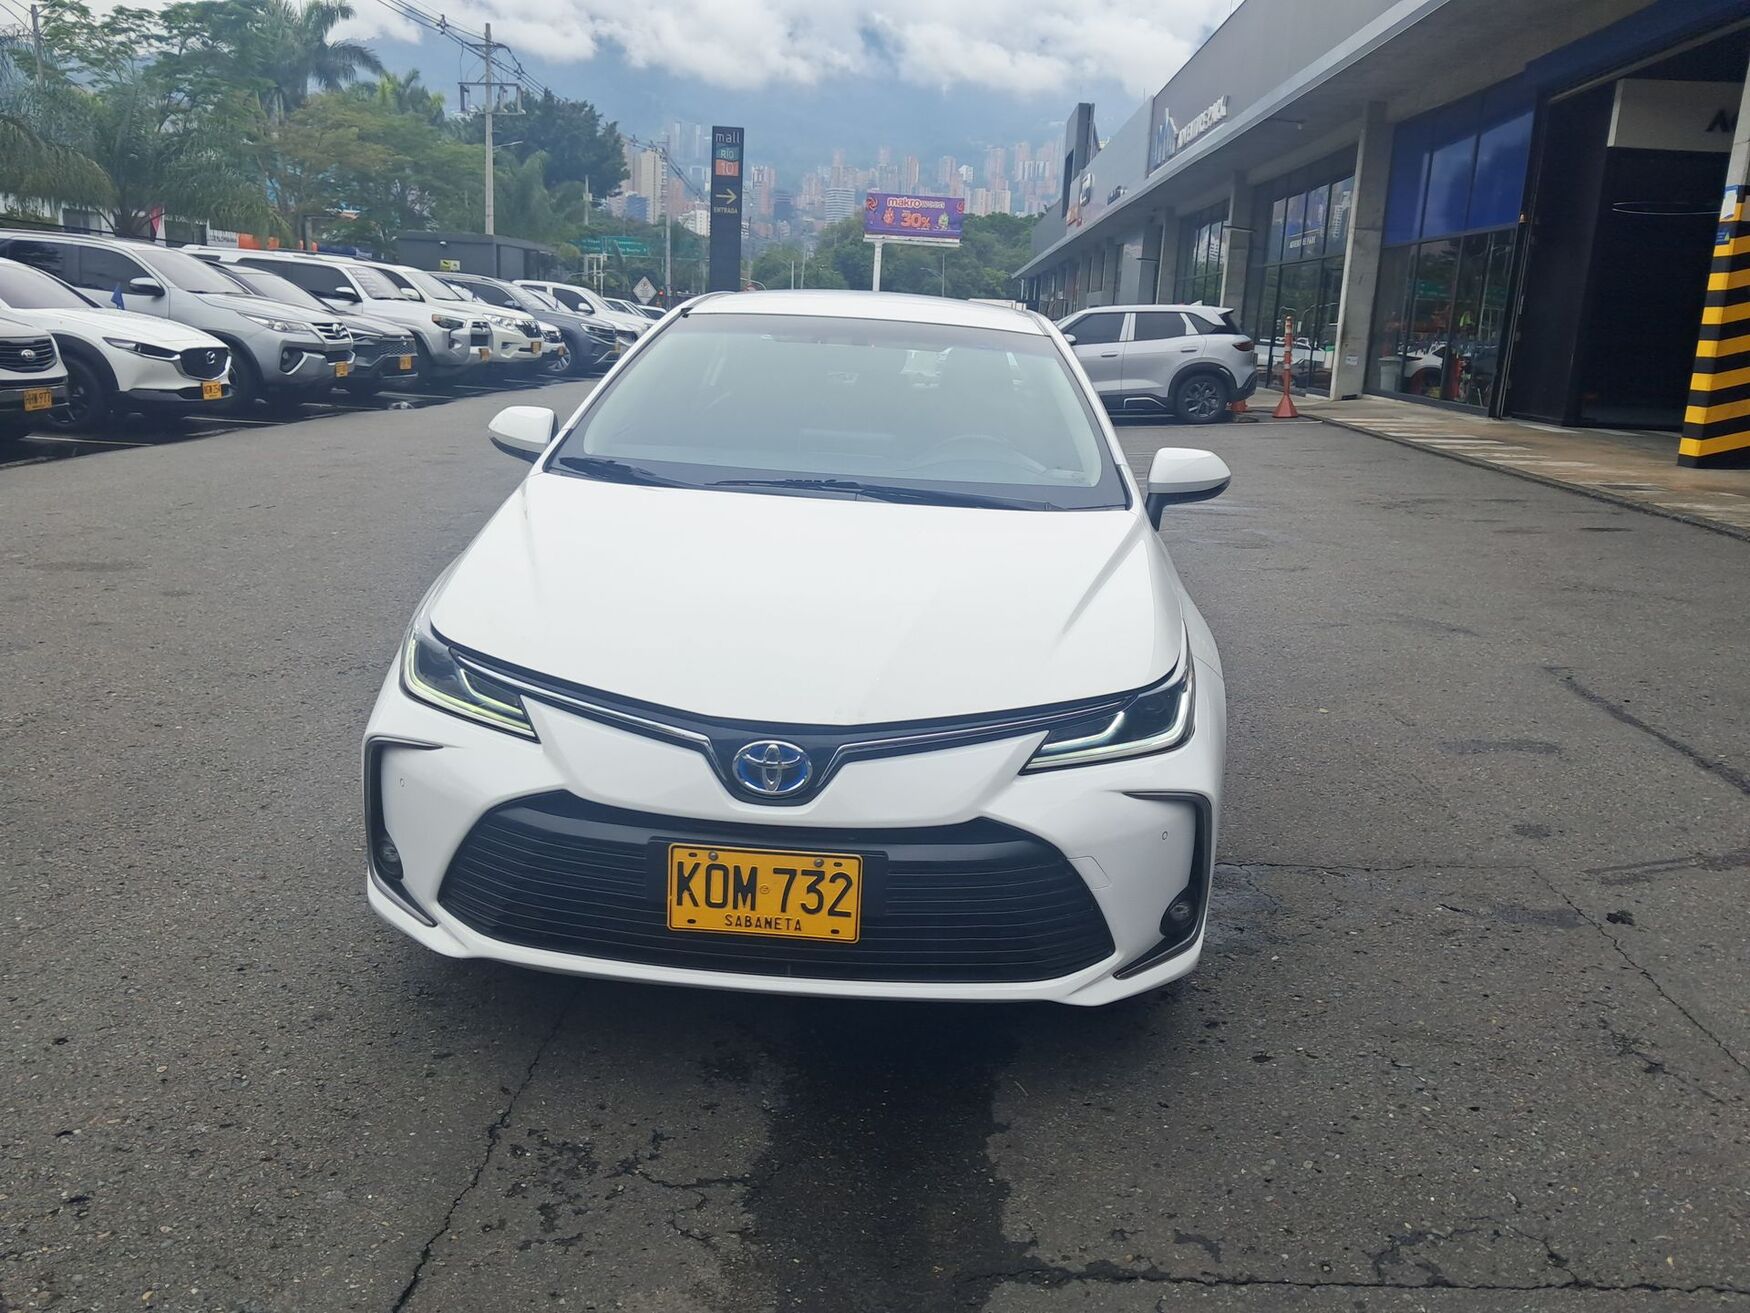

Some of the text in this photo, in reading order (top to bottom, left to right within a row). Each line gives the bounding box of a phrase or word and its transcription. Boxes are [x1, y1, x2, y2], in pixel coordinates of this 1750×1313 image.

[715, 132, 740, 144] mall
[713, 206, 738, 214] ENTRADA
[901, 211, 931, 228] 30%
[676, 861, 853, 918] KOM 732
[724, 914, 802, 931] SABANETA
